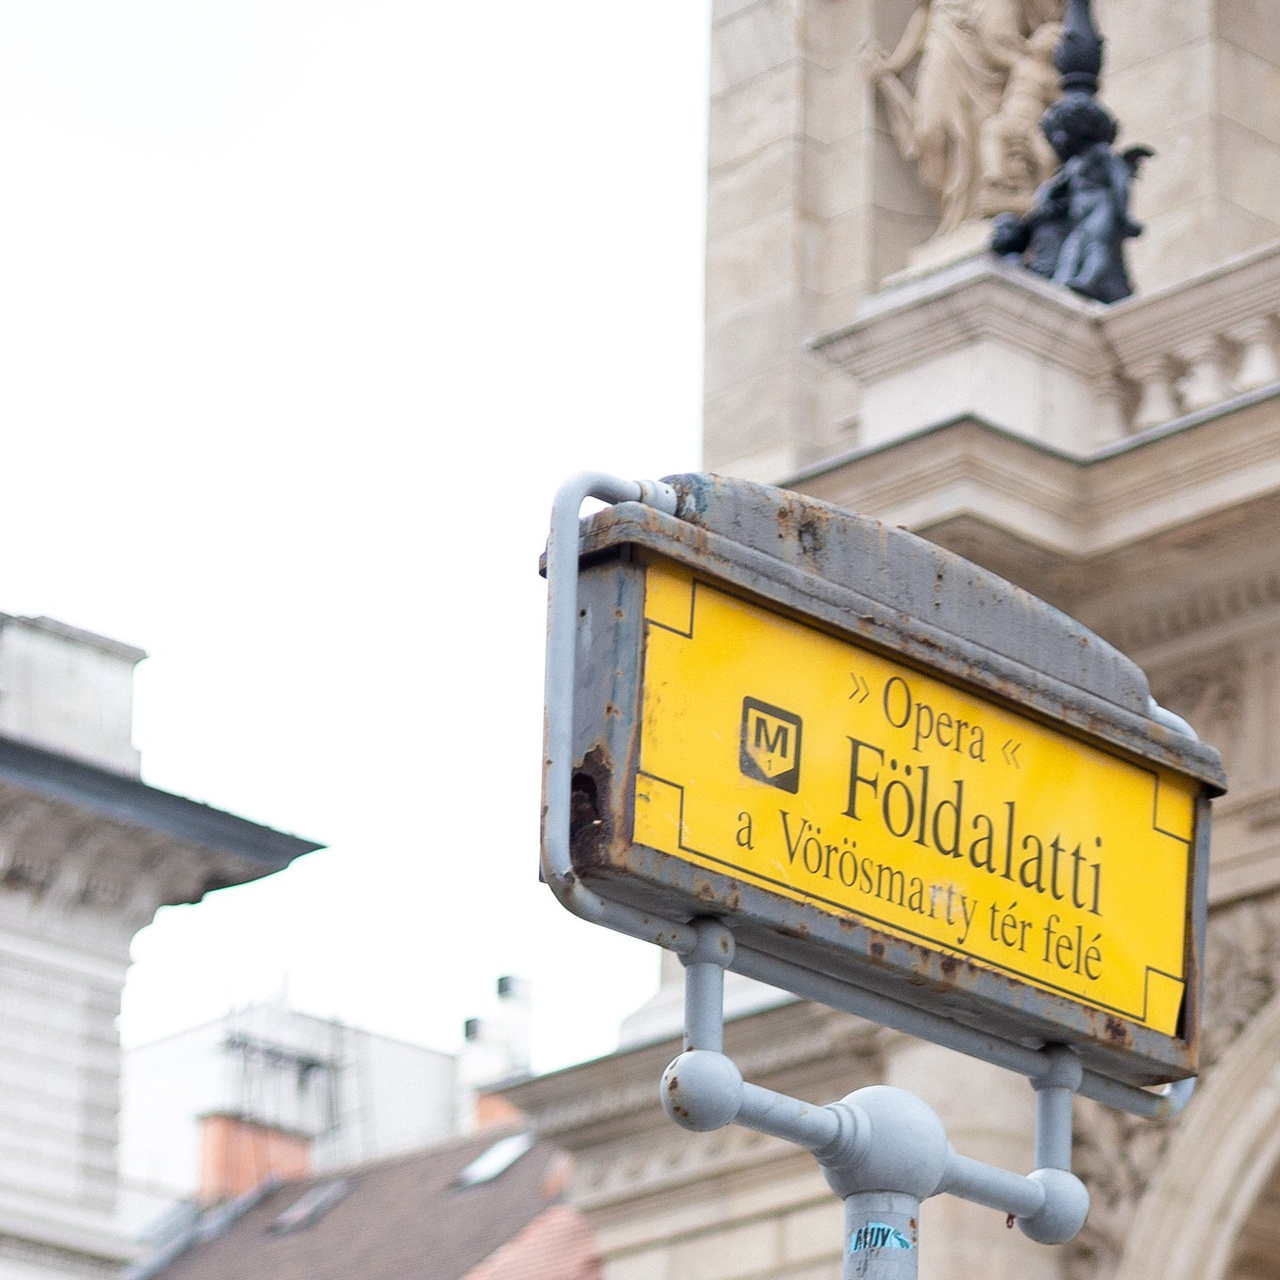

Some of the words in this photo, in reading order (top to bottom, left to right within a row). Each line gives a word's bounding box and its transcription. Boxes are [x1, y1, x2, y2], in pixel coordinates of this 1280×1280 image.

[755, 715, 788, 758] M
[883, 676, 986, 763] Opera
[841, 735, 1103, 917] Földalatti
[736, 811, 754, 850] a
[779, 809, 978, 945] Vörösmarty
[989, 901, 1033, 952] tér
[1042, 913, 1103, 981] felé
